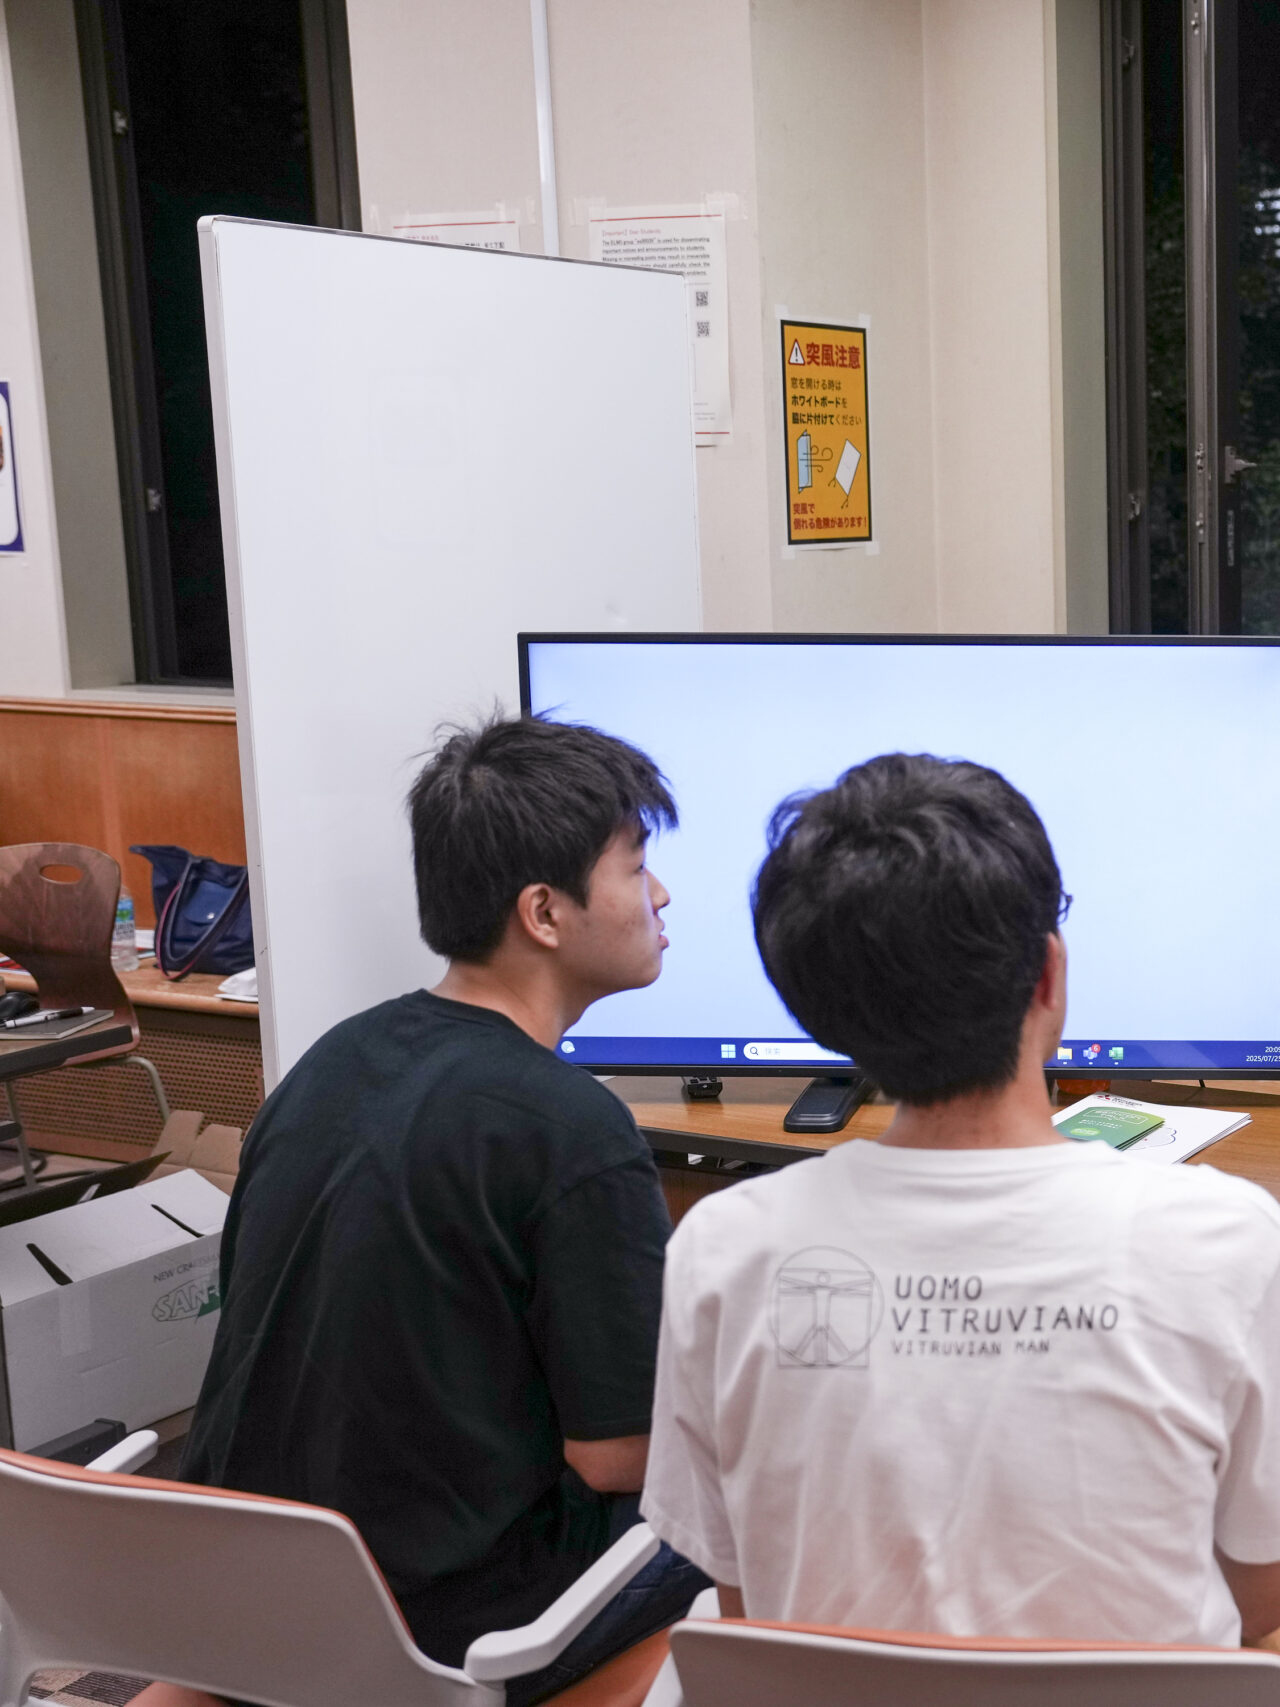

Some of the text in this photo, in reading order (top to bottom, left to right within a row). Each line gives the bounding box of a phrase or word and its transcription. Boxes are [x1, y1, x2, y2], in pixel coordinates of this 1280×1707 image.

[806, 342, 860, 369] 突風注意
[791, 377, 841, 391] 窓を開ける時は
[792, 395, 847, 408] ホワイトボードを
[793, 503, 815, 514] 突風で
[895, 1275, 983, 1301] UOMO
[892, 1304, 1118, 1334] VITRUVIANO
[893, 1339, 1049, 1357] VITRUVIAN MAN
